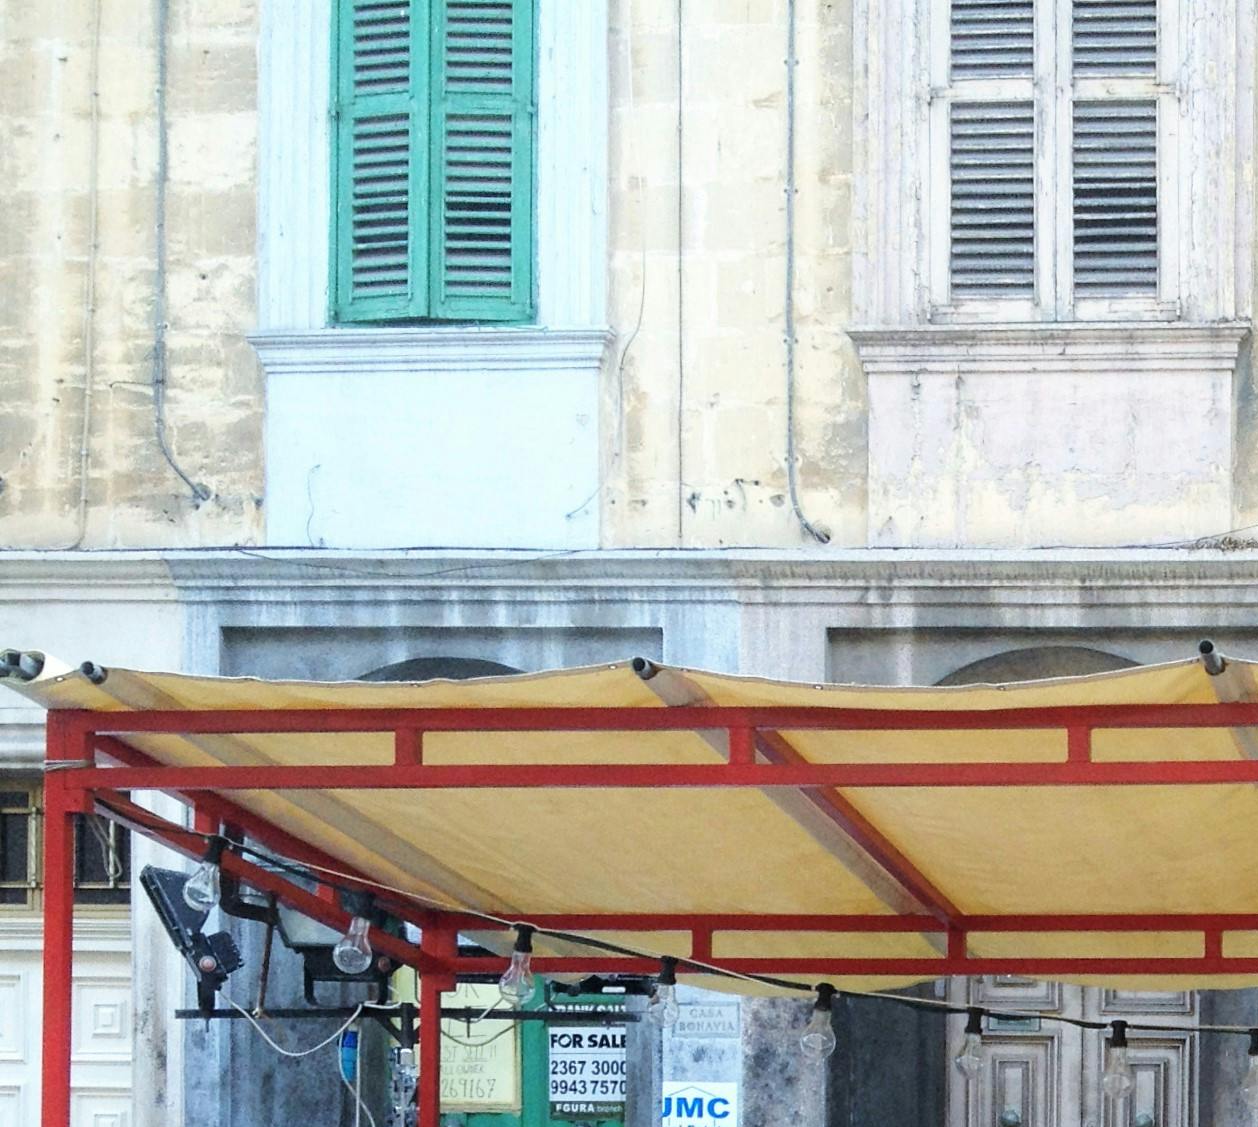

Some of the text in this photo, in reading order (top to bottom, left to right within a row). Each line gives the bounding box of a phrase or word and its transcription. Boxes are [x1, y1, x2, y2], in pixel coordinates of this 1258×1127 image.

[689, 1008, 723, 1018] CASA
[680, 1021, 735, 1031] BONAVIA
[550, 1033, 584, 1048] FOR
[551, 1061, 626, 1075] 2367 3000
[551, 1080, 626, 1094] 9943 7570
[556, 1104, 595, 1112] FGURA
[662, 1097, 730, 1119] JMC
